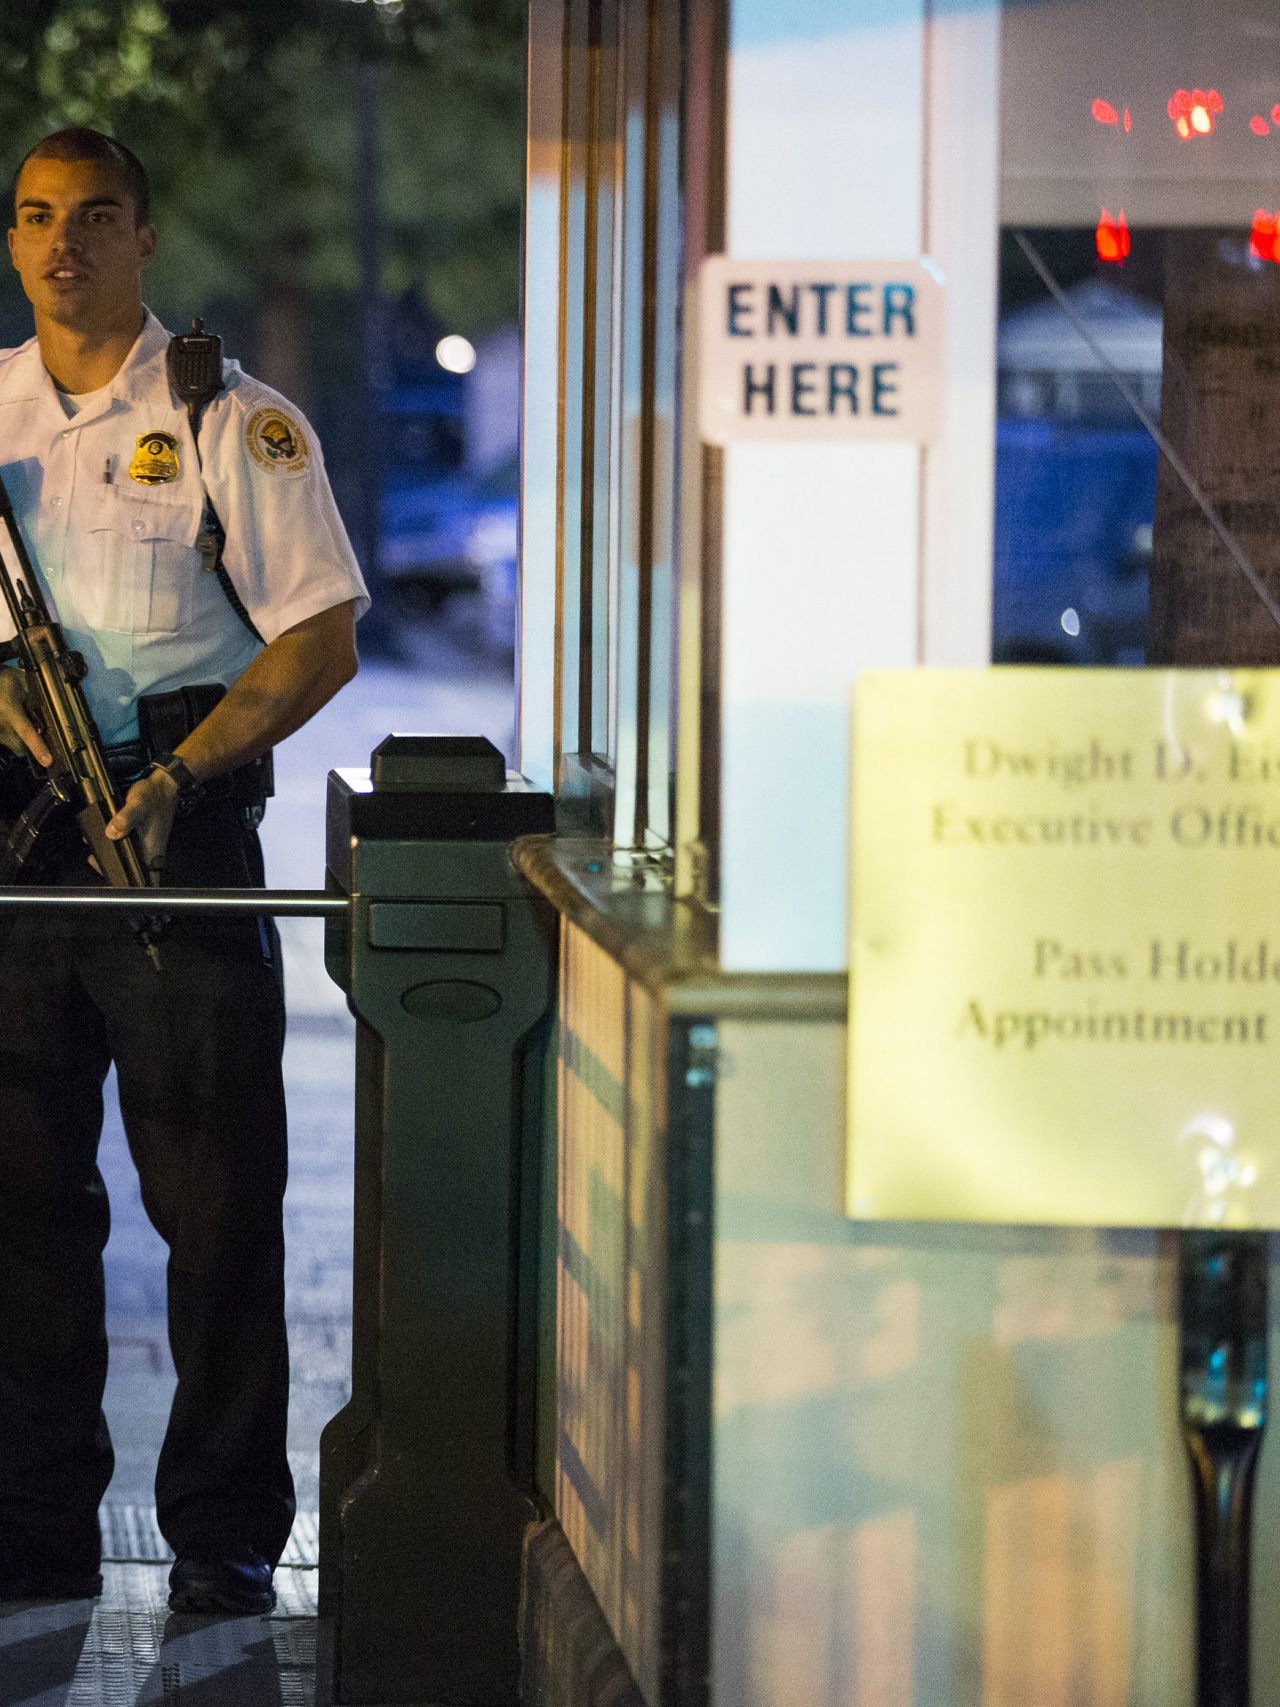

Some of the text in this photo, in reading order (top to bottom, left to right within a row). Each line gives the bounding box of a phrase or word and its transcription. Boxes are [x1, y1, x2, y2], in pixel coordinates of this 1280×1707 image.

[727, 282, 916, 336] ENTER
[744, 363, 899, 416] HERE
[965, 739, 1280, 788] Dwight D. Ei
[932, 801, 1154, 844] Executive
[1034, 938, 1128, 980] Pass
[956, 999, 1267, 1050] Appointment
